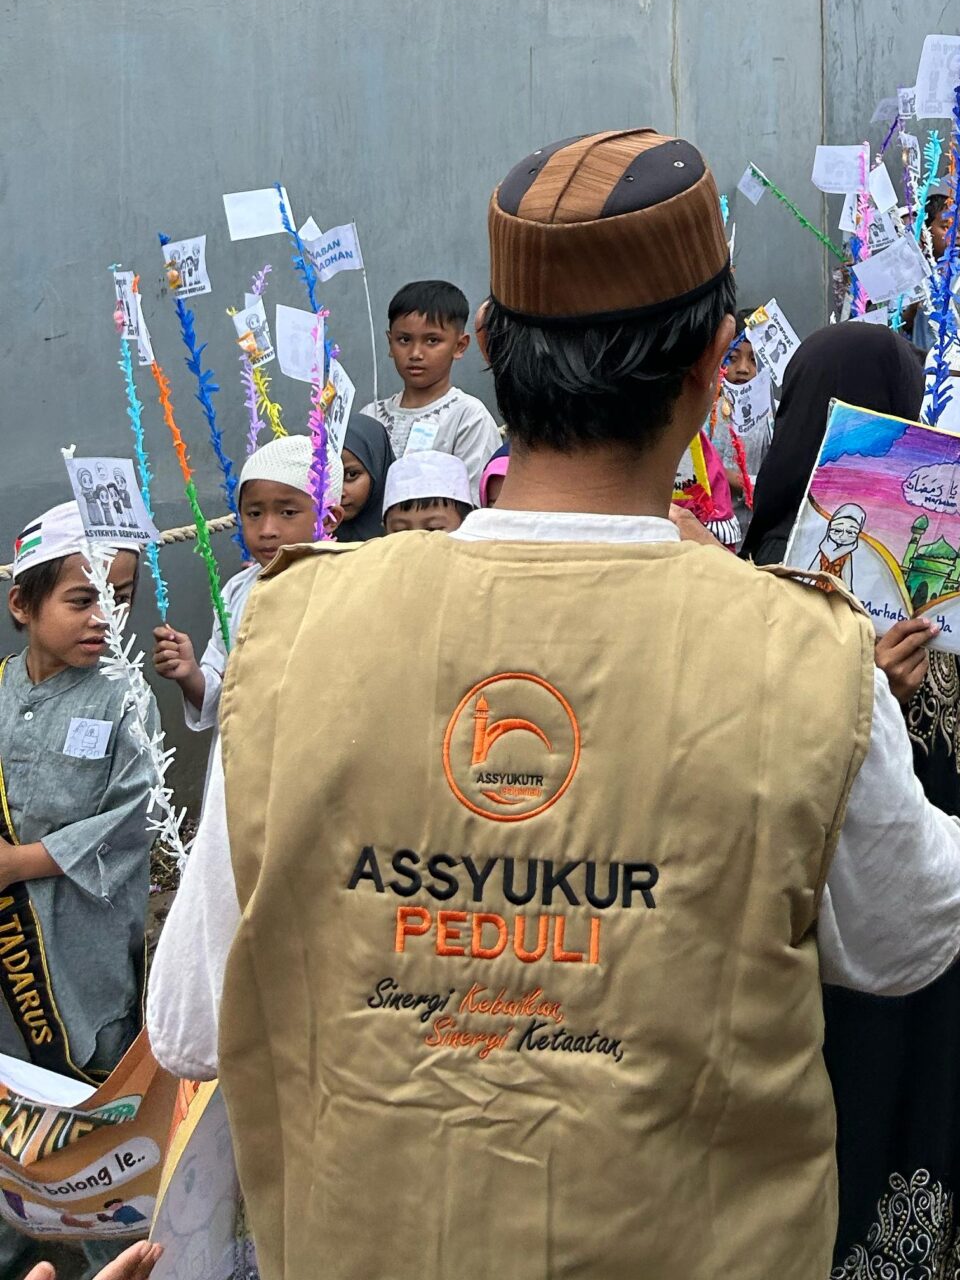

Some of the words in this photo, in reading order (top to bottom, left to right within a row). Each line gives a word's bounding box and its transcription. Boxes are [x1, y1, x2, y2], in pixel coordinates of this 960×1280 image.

[937, 615, 952, 632] Ya
[476, 772, 544, 786] ASSYUKUTR
[347, 845, 660, 910] ASSYUKUR
[394, 906, 601, 964] PEDULI
[367, 977, 455, 1023] Sinergi
[425, 1017, 513, 1060] Sinergi
[516, 1019, 625, 1063] Ketaatan,
[44, 1165, 113, 1196] bolong
